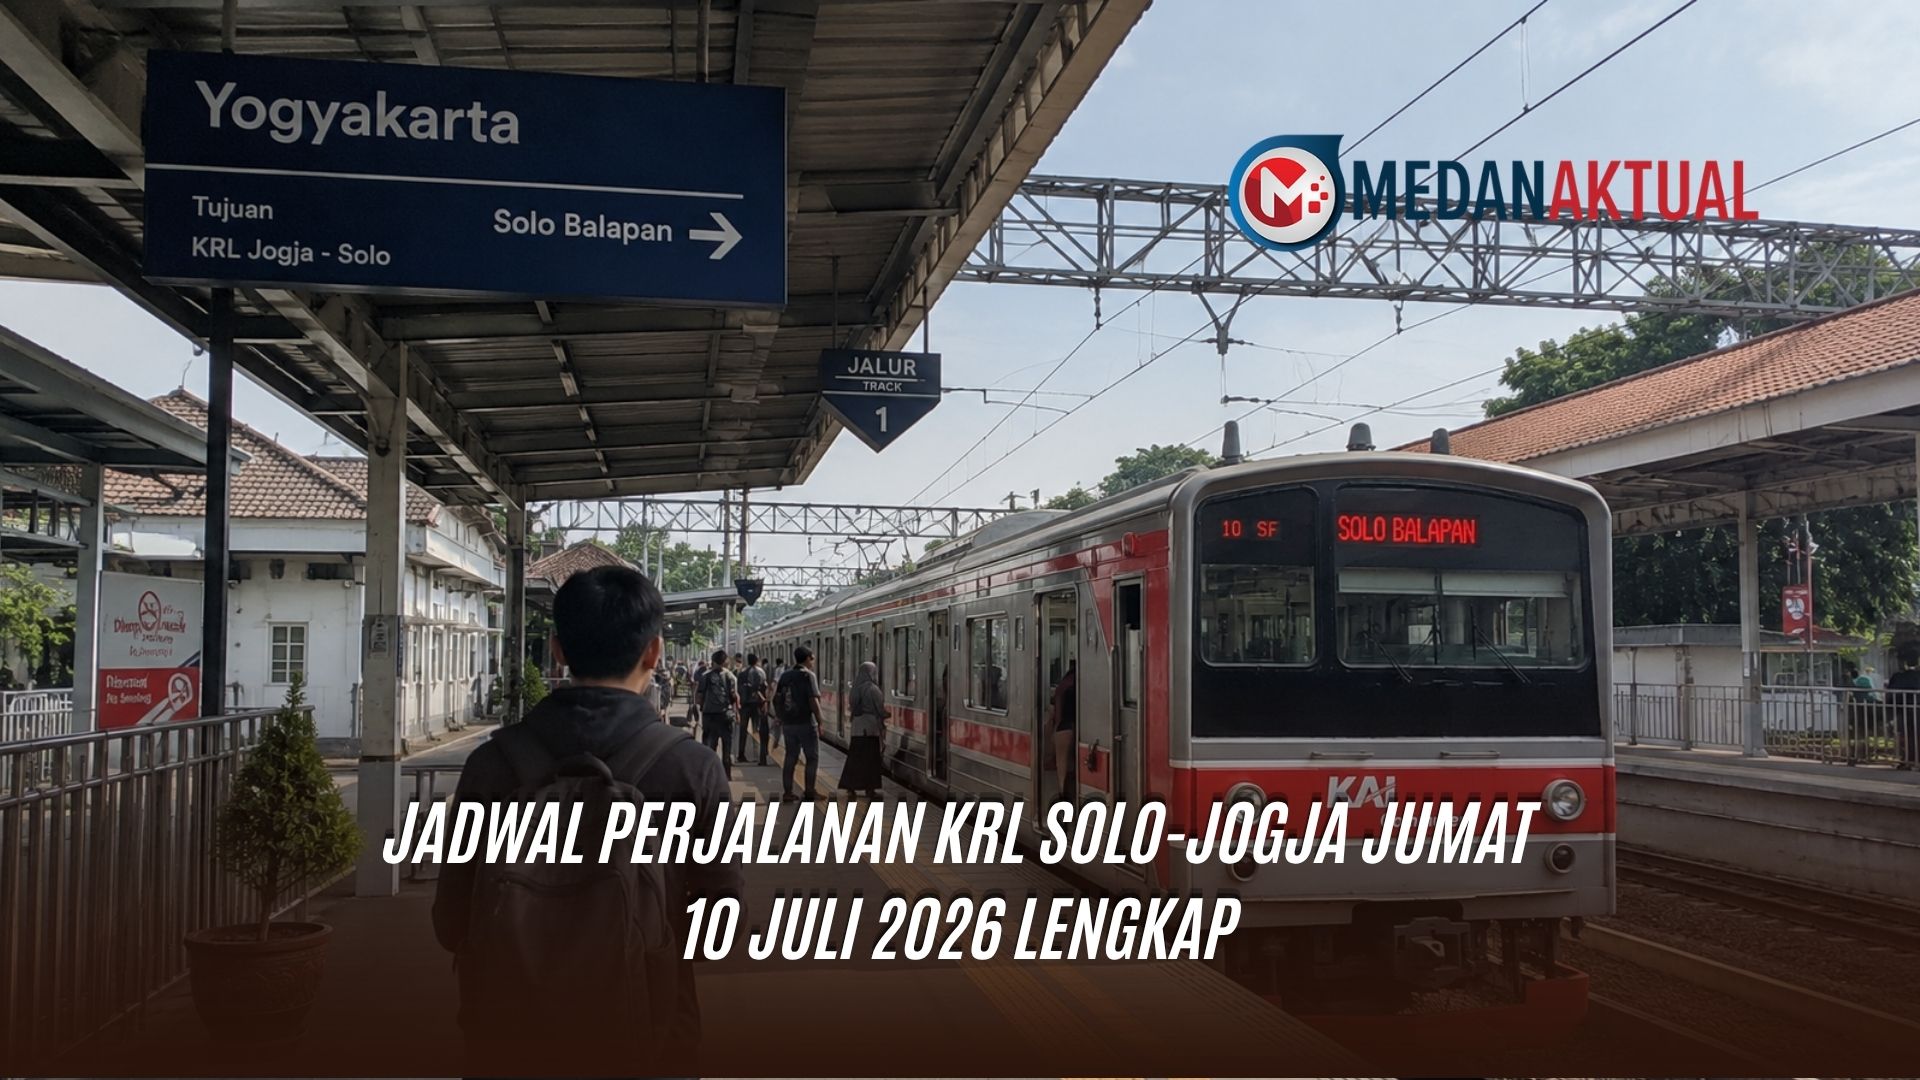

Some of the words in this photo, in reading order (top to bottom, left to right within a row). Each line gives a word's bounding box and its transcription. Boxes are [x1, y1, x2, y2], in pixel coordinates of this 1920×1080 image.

[195, 80, 520, 145] Yogyakarta
[192, 196, 274, 223] Tujuan
[493, 208, 555, 236] Solo
[564, 212, 673, 245] Balapan
[192, 236, 241, 259] KRL
[247, 239, 314, 266] Jogja
[338, 243, 391, 267] Solo
[848, 356, 917, 376] JALUR
[863, 381, 903, 392] TRACK
[875, 406, 887, 432] 1
[1222, 520, 1242, 537] 10
[1257, 520, 1279, 537] SF
[1338, 515, 1387, 542] SOLO
[1392, 516, 1476, 544] BALAPAN
[1327, 776, 1397, 808] KAI
